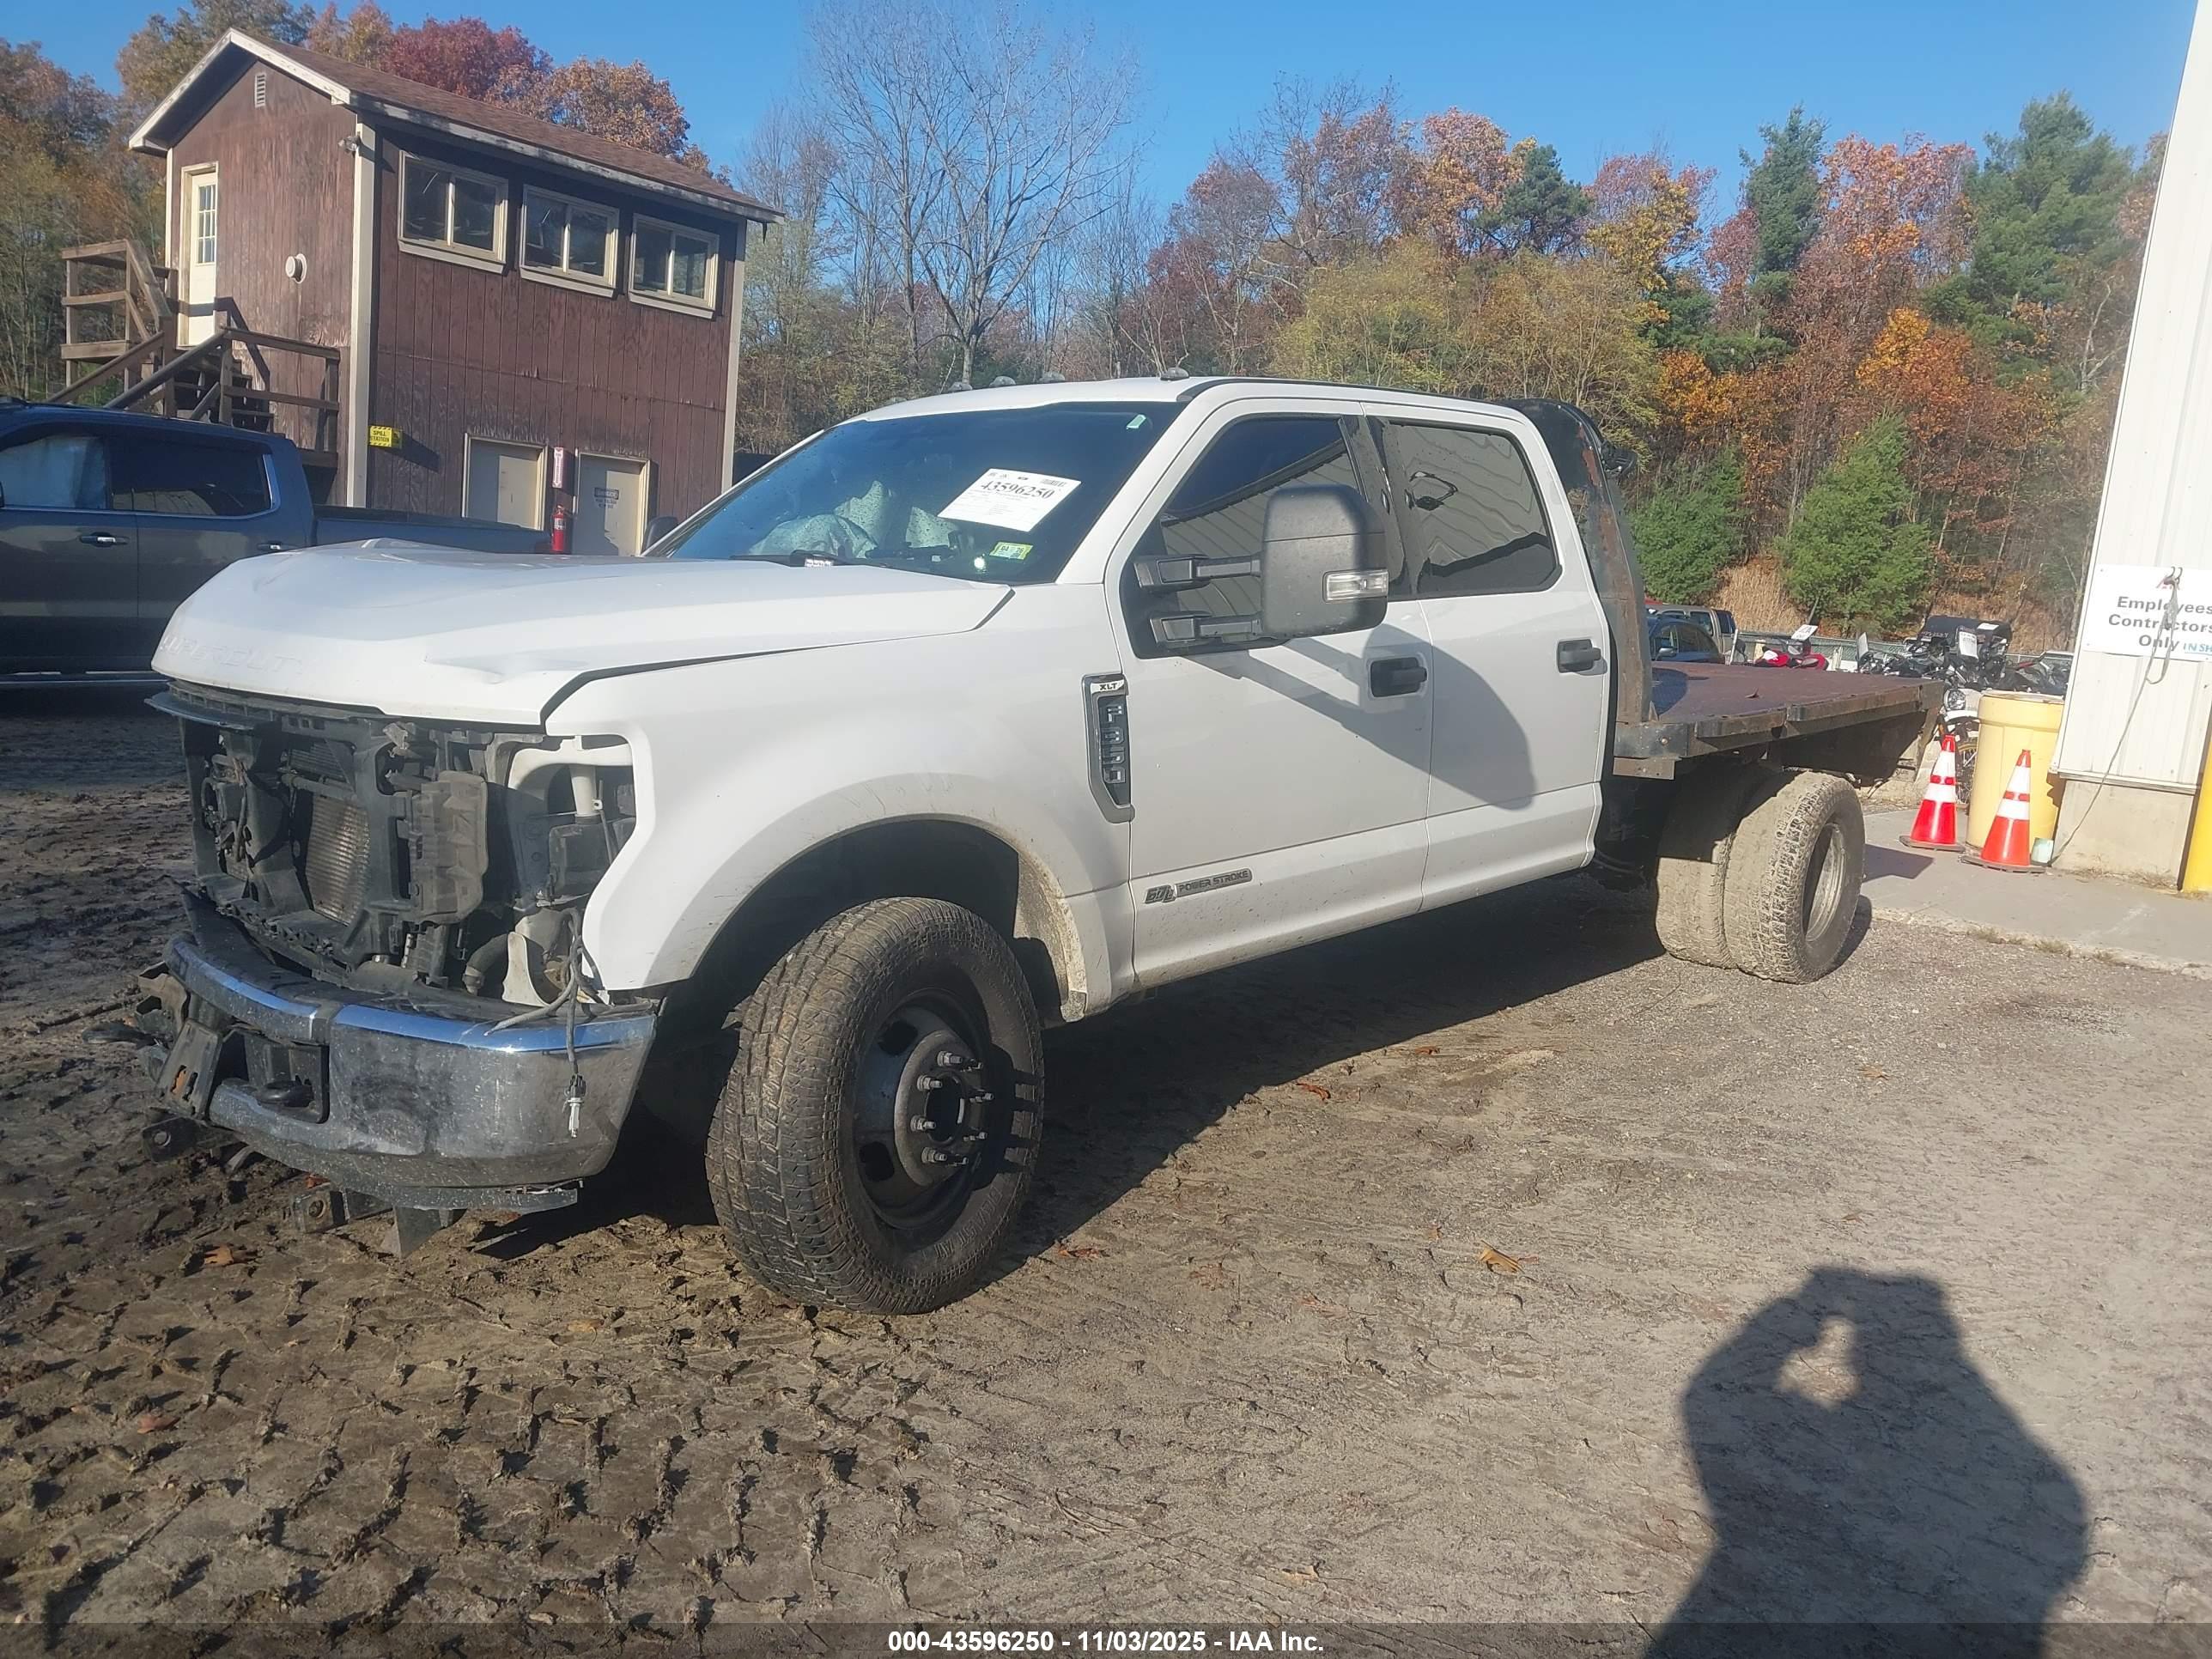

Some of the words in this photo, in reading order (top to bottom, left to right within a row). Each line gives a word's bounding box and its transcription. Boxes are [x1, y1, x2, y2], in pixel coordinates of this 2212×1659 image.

[981, 480, 1055, 499] 43596250
[2138, 635, 2179, 652] Only
[1099, 683, 1118, 691] XLT
[1179, 878, 1212, 893] POWER
[1212, 869, 1249, 885] STROKE
